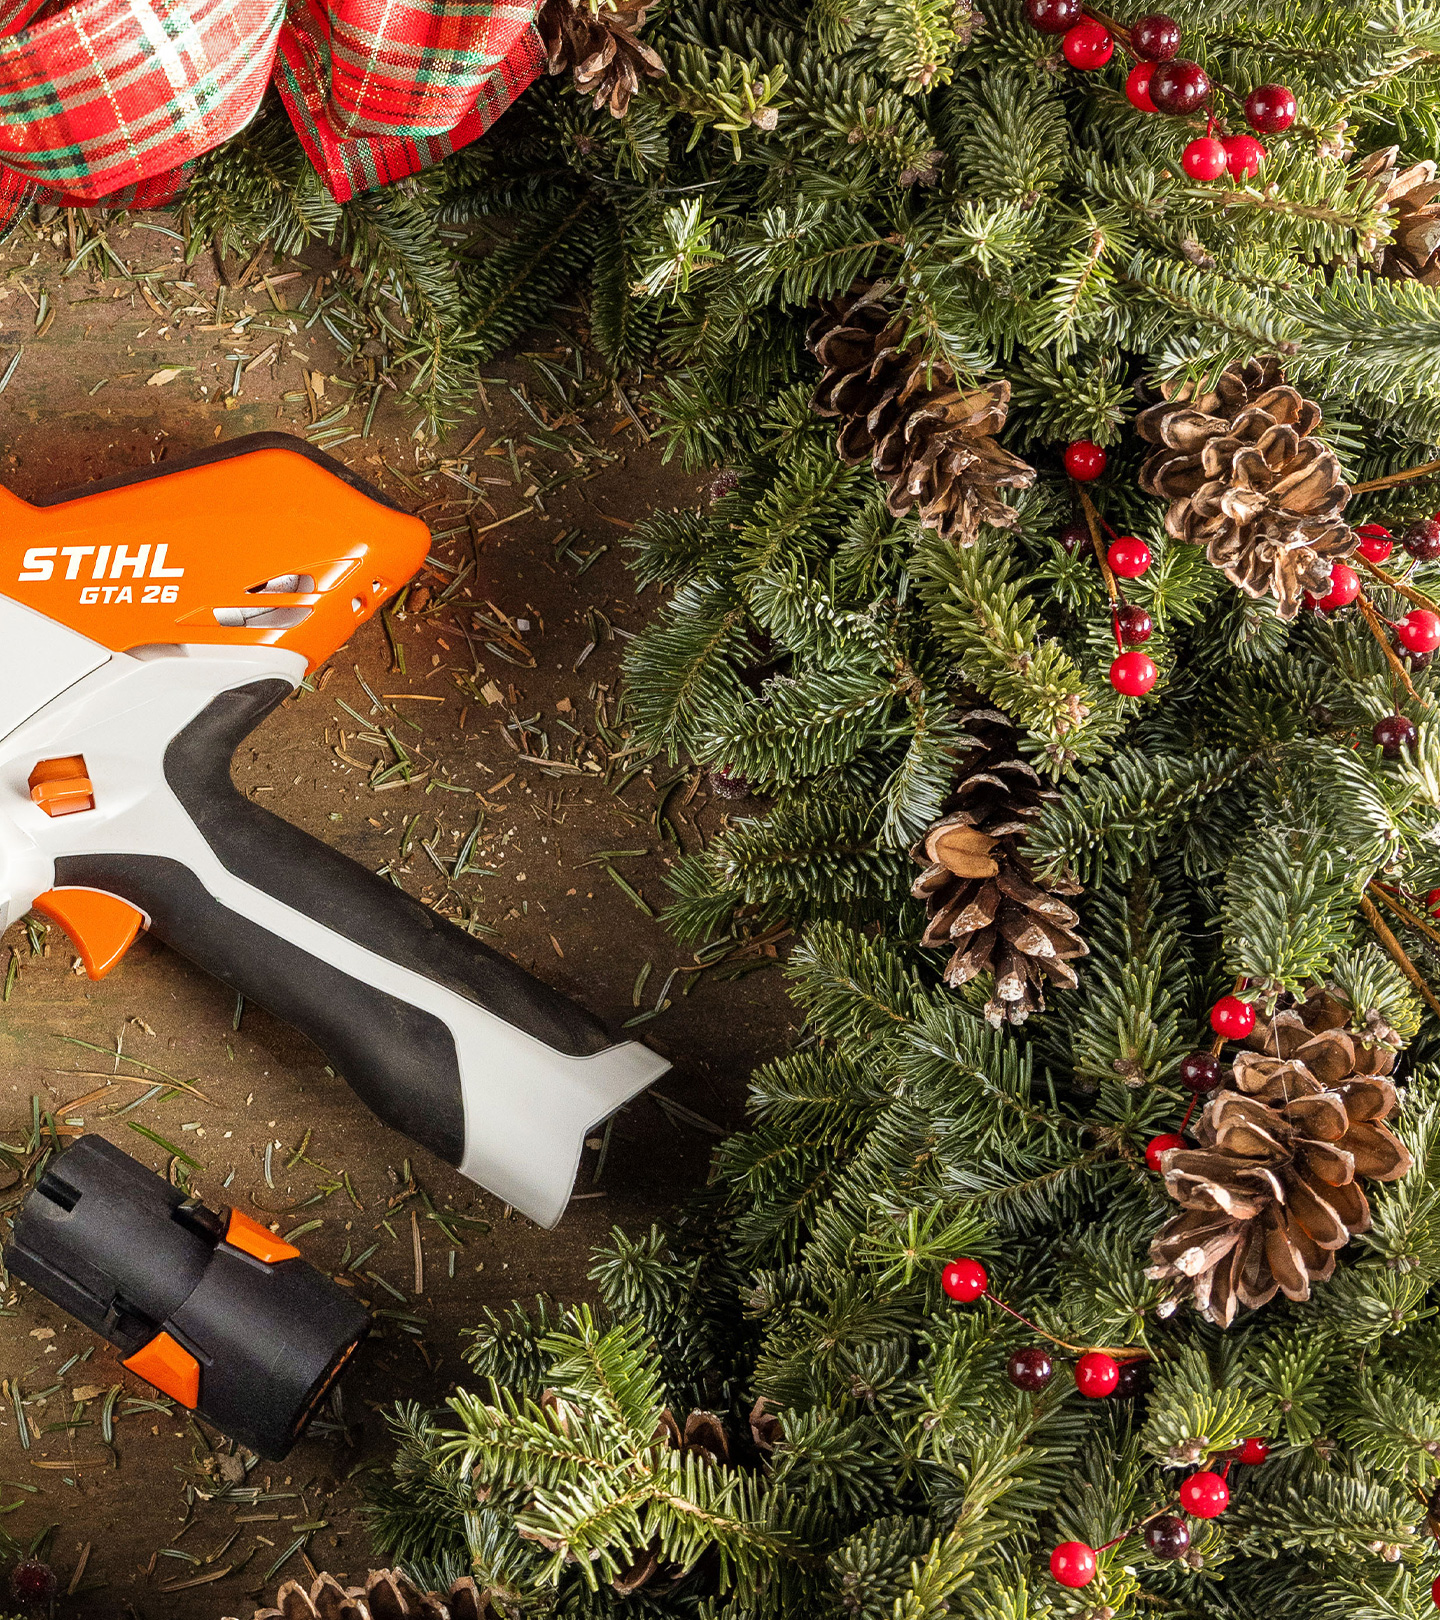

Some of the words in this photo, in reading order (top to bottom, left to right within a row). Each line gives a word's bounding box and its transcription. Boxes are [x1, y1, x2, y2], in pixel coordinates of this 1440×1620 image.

[17, 543, 185, 582] STIHL
[79, 586, 133, 605] GTA
[140, 585, 180, 604] 26
